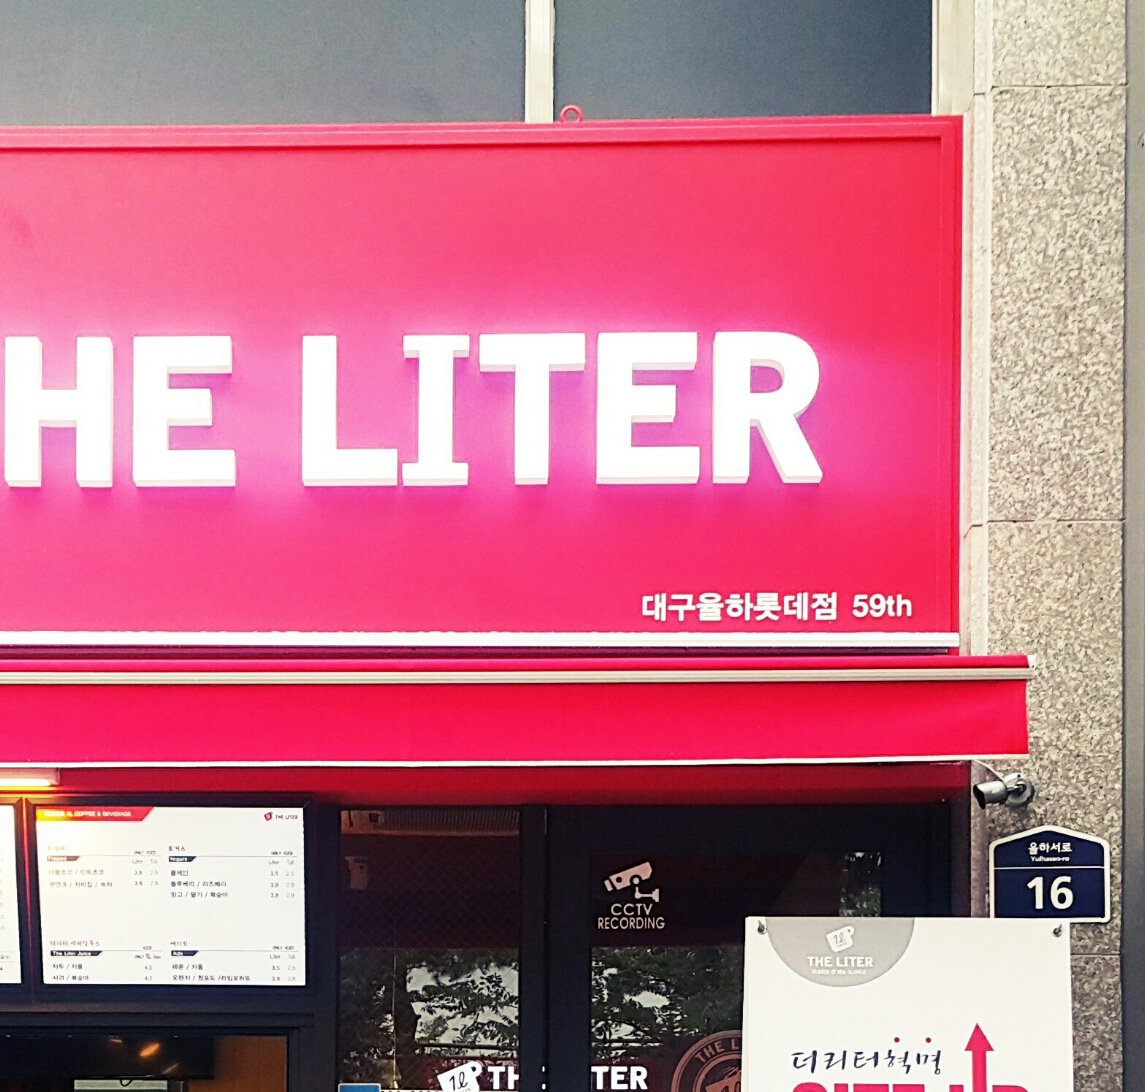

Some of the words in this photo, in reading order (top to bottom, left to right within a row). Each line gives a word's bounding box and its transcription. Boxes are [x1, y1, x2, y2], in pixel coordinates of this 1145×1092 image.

[302, 330, 823, 487] LITER
[642, 592, 838, 622] 대구율하롯데점
[852, 594, 913, 618] 59th
[1027, 876, 1074, 910] 16
[611, 904, 653, 915] CCTV
[598, 917, 665, 929] RECORDING
[807, 956, 832, 967] THE
[836, 956, 873, 967] LITER
